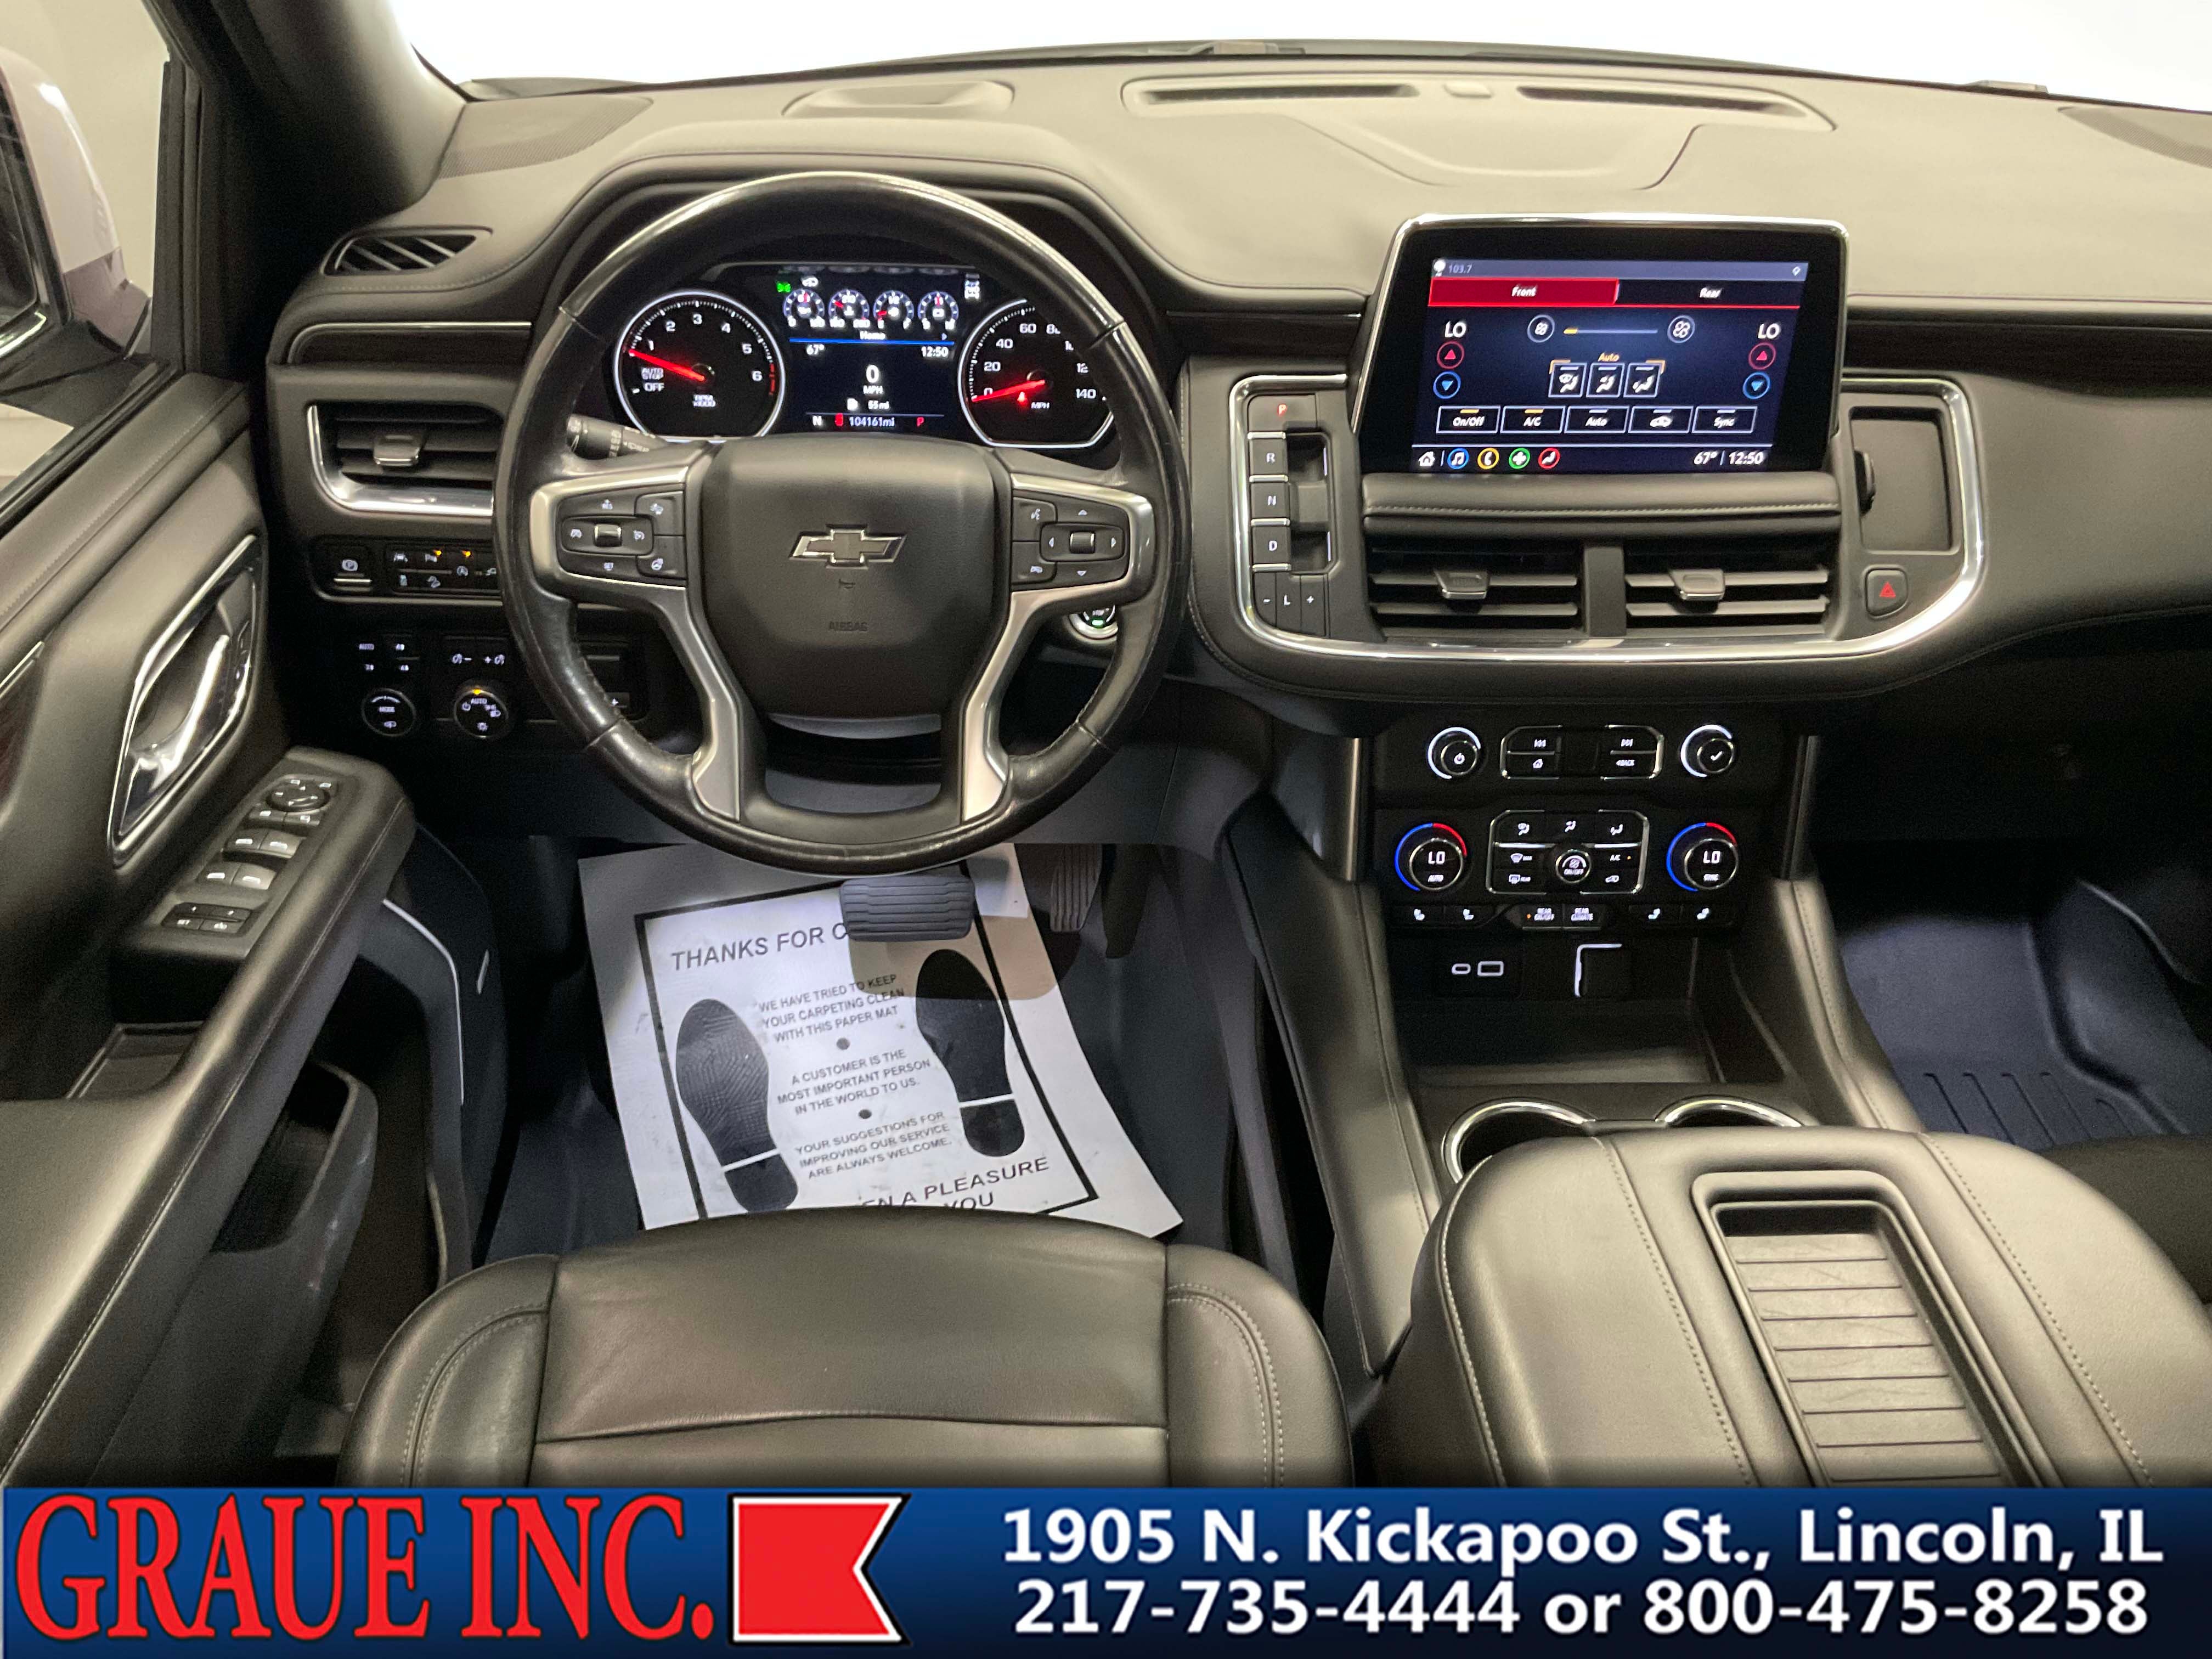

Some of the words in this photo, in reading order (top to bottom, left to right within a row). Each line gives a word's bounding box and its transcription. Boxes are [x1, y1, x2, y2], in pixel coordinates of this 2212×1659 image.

[1448, 264, 1472, 274] 103.7
[1511, 285, 1537, 297] Front
[1700, 287, 1722, 298] Rear
[692, 313, 703, 325] 3
[665, 320, 676, 332] 2
[721, 322, 731, 334] 4
[1019, 323, 1037, 334] 60
[1444, 320, 1467, 338] LO
[1757, 322, 1780, 339] LO
[648, 339, 655, 352] 1
[741, 342, 753, 355] 5
[995, 338, 1014, 349] 40
[921, 346, 949, 357] 12:50
[865, 364, 880, 383] 0
[983, 361, 1001, 373] 20
[751, 370, 763, 382] 6
[644, 382, 664, 392] OFF
[863, 385, 884, 395] MPH
[1075, 388, 1097, 400] 140
[1277, 403, 1288, 416] P
[1266, 452, 1276, 464] R
[1729, 451, 1765, 465] 12:50
[1267, 495, 1277, 506] N
[1268, 539, 1278, 551] D
[1283, 594, 1291, 606] L
[1427, 851, 1446, 864] LO
[1703, 850, 1720, 864] LO
[672, 936, 769, 971] THANKS
[776, 927, 825, 952] FOR
[758, 1000, 776, 1013] WE
[778, 992, 811, 1011] HAVE
[812, 985, 848, 1002] TRIED
[849, 980, 865, 992] TO
[867, 973, 897, 988] KEEP
[763, 1011, 795, 1029] YOUR
[798, 998, 865, 1021] CARPETING
[866, 988, 905, 1006] CLEAN
[773, 1027, 805, 1043] WITH
[805, 1018, 833, 1035] THIS
[836, 1011, 873, 1029] PAPER
[875, 1005, 899, 1020] MAT
[791, 1075, 801, 1086] A
[802, 1058, 868, 1082] CUSTOMER
[870, 1054, 882, 1066] IS
[882, 1048, 907, 1063] THE
[777, 1086, 811, 1105] MOST
[813, 1070, 880, 1095] IMPORTANT
[883, 1058, 932, 1079] PERSON
[794, 1104, 808, 1115] IN
[809, 1097, 835, 1111] THE
[836, 1085, 880, 1105] WORLD
[881, 1080, 899, 1094] TO
[900, 1076, 921, 1089] US.
[795, 1140, 830, 1156] YOUR
[833, 1117, 918, 1146] SUGGESTIONS
[919, 1110, 945, 1124] FOR
[799, 1143, 868, 1169] IMPROVING
[870, 1136, 898, 1150] OUR
[899, 1123, 951, 1143] SERVICE
[809, 1165, 834, 1180] ARE
[836, 1150, 887, 1172] ALWAYS
[886, 1136, 953, 1160] WELCOME.
[924, 1156, 1050, 1200] PLEASURE
